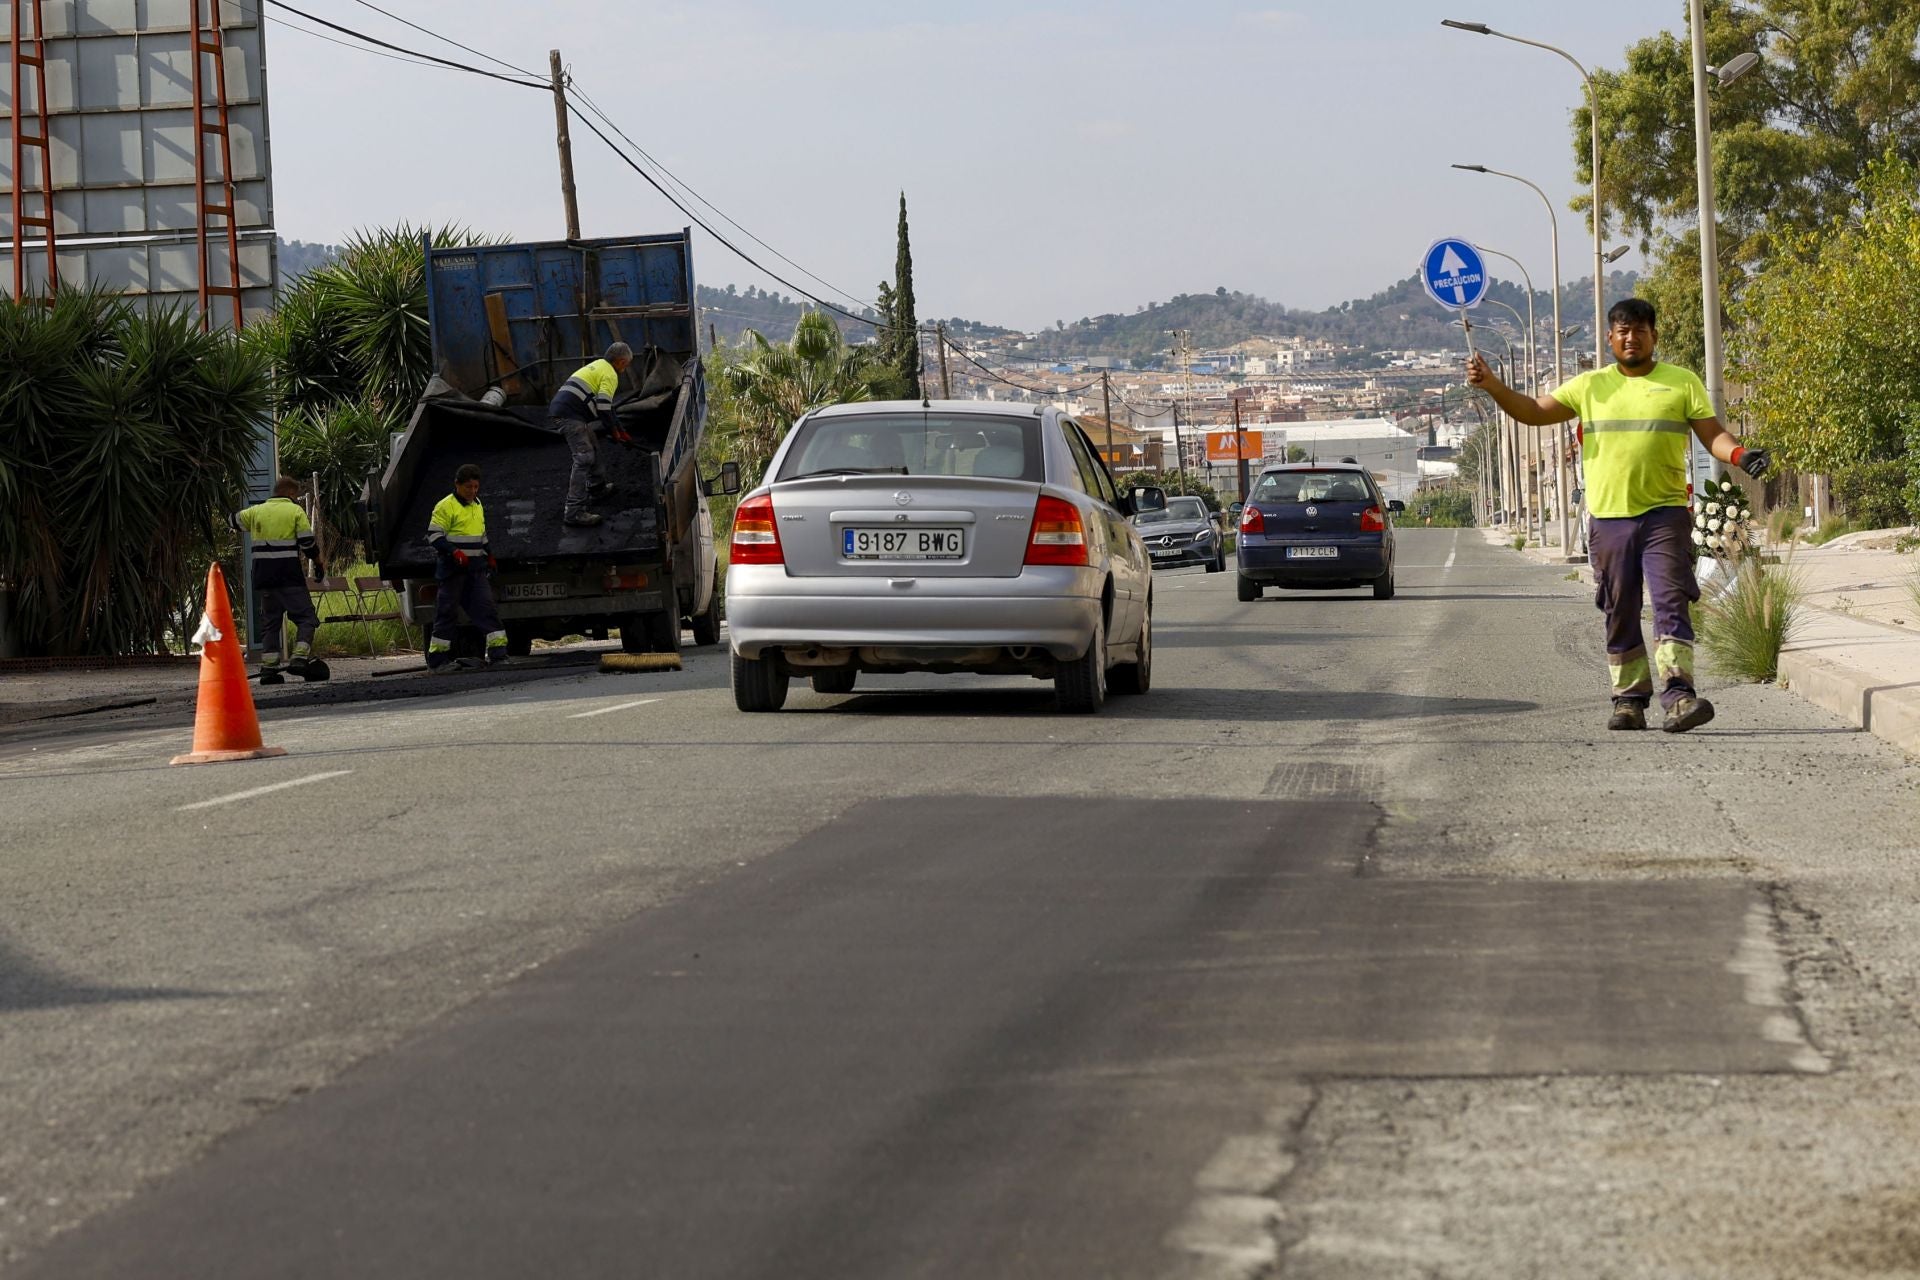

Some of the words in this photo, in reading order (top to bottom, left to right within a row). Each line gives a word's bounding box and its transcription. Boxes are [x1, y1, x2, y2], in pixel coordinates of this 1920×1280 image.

[1433, 273, 1481, 289] PRECAUCION
[858, 533, 907, 551] 9187
[919, 533, 958, 551] BWG
[1293, 547, 1315, 556] 2112
[1318, 547, 1336, 555] CLR
